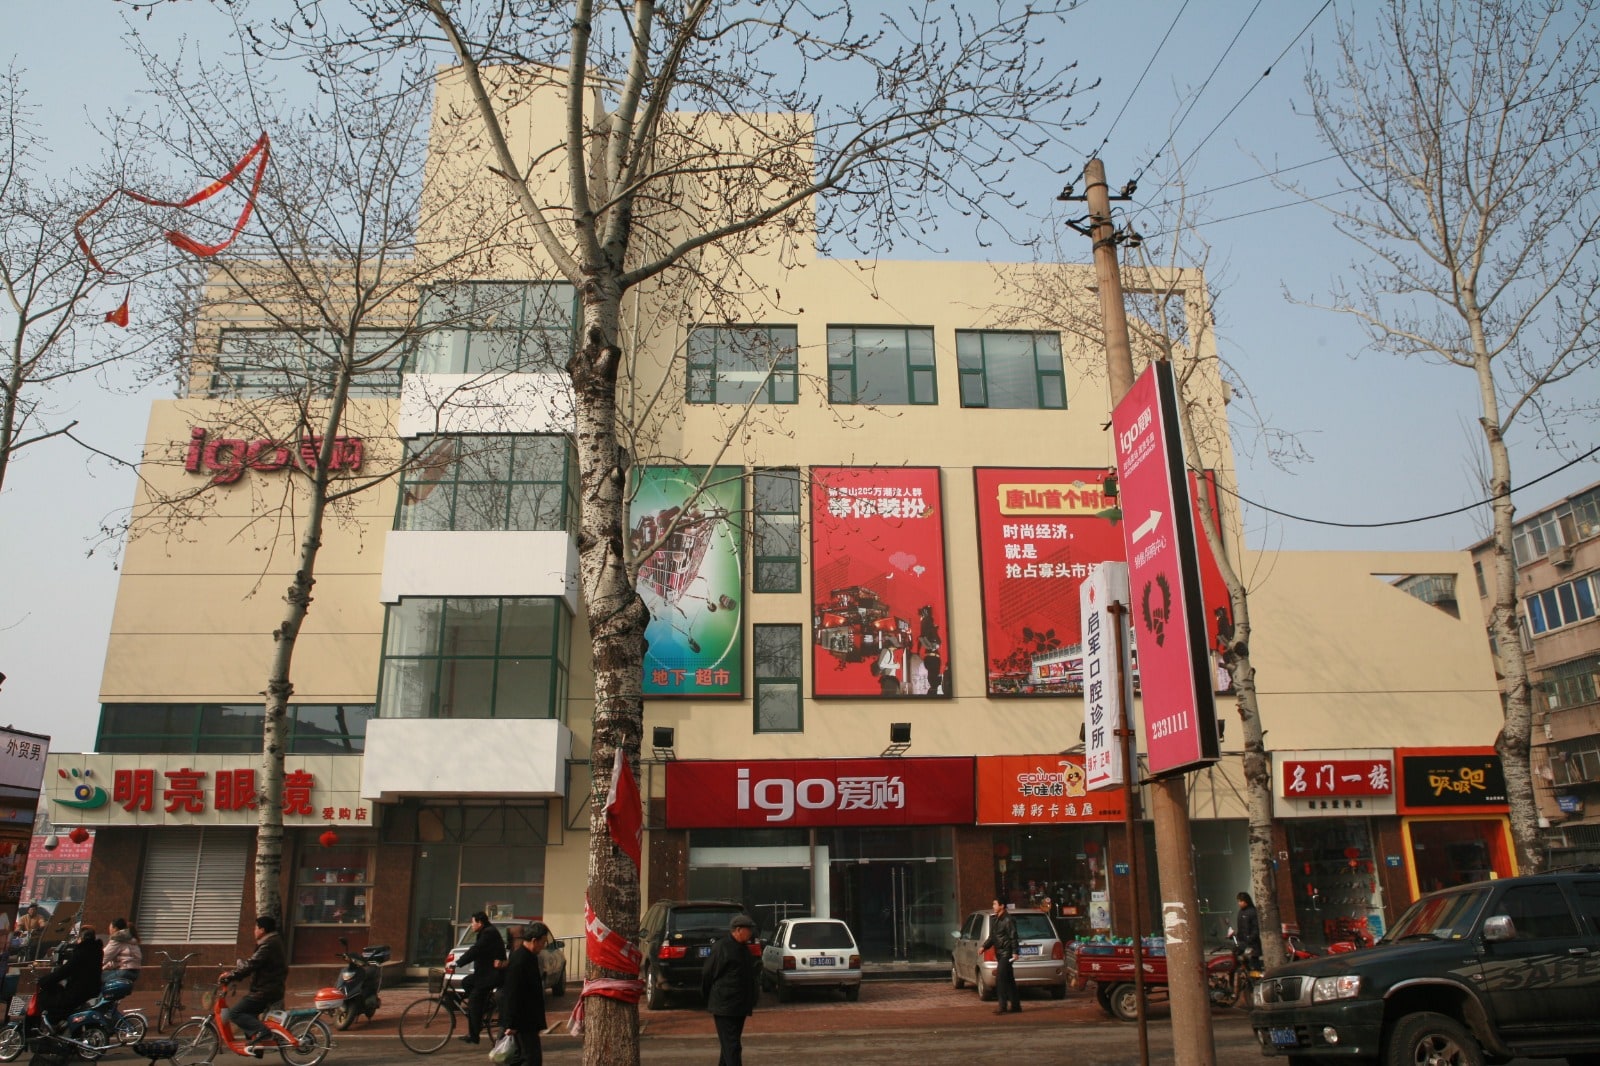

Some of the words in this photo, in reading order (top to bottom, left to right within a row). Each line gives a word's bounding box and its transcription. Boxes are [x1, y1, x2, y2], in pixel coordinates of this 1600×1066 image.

[827, 497, 926, 518] 等你装扮
[1004, 543, 1037, 559] 就是
[652, 668, 687, 686] 地下
[695, 668, 730, 686] 超市
[1151, 710, 1189, 740] 2331111
[1289, 764, 1390, 793] 名门一族
[322, 807, 368, 821] 爱购店
